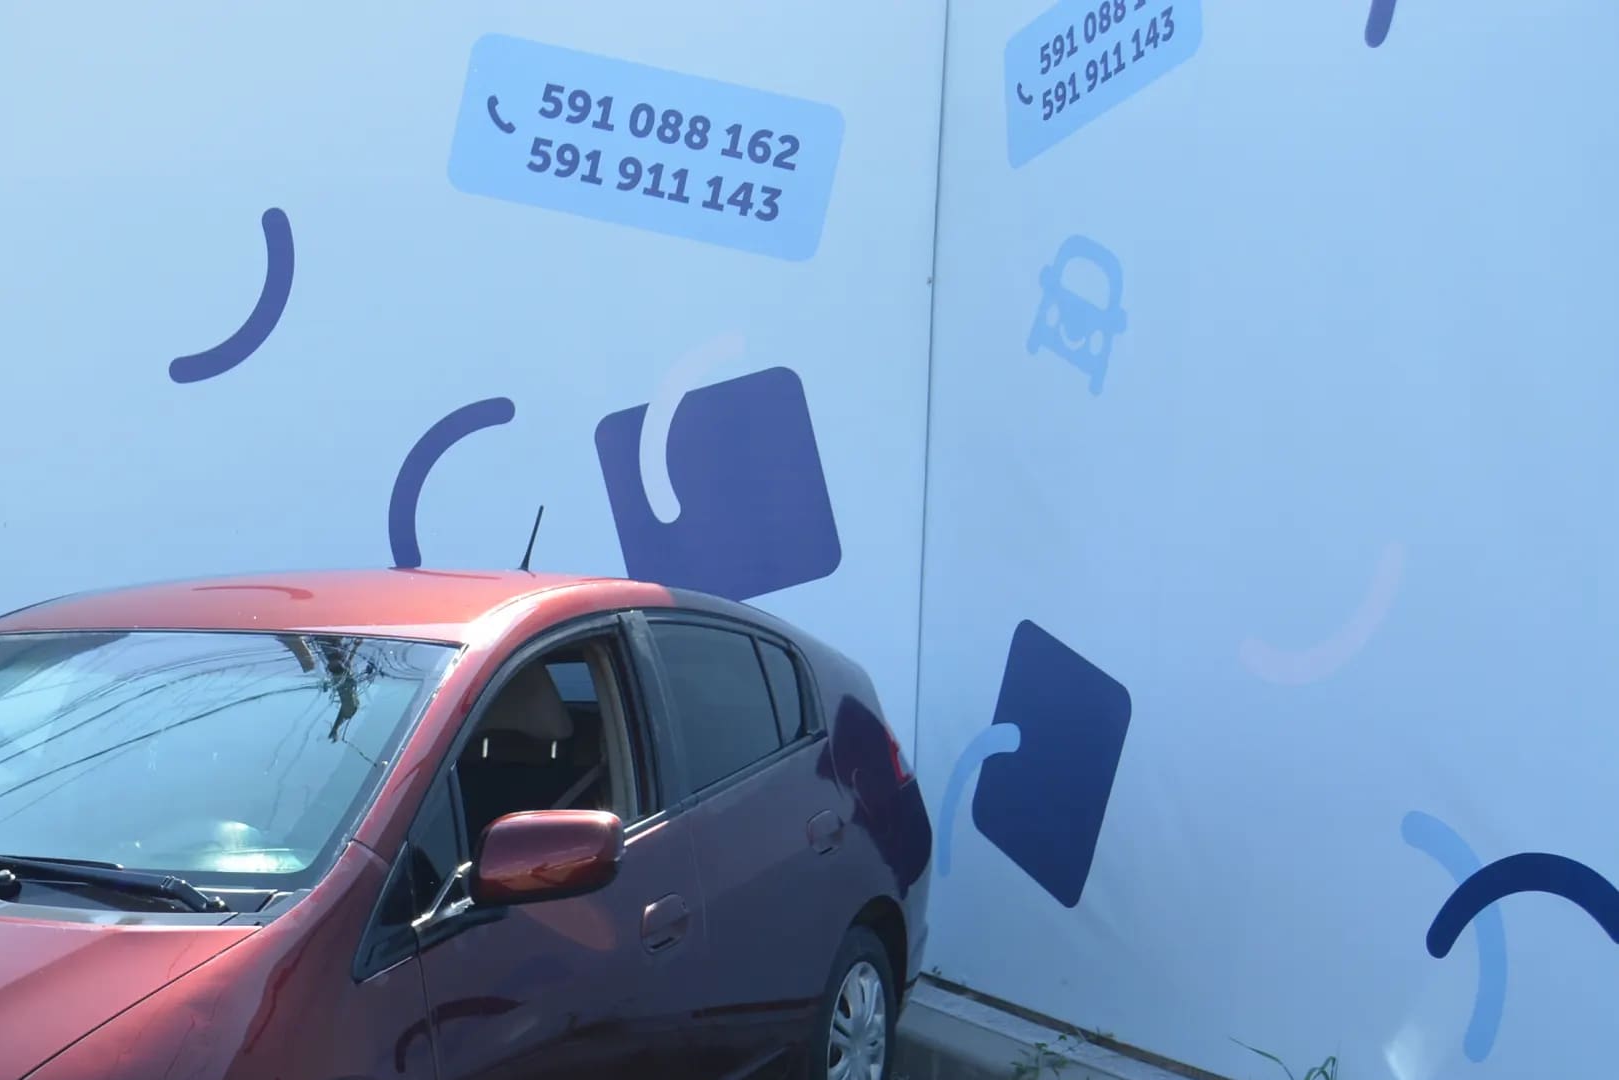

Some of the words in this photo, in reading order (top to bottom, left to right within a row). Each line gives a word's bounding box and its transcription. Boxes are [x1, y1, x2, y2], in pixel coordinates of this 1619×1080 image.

[1039, 25, 1079, 75] 591
[1083, 0, 1127, 44] 088
[1041, 72, 1081, 121] 591
[1085, 41, 1126, 93] 911
[1131, 6, 1175, 63] 143
[538, 83, 615, 132] 591
[629, 102, 711, 150] 088
[721, 123, 801, 171] 162
[526, 137, 603, 185] 591
[616, 156, 690, 204] 911
[702, 175, 783, 222] 143
